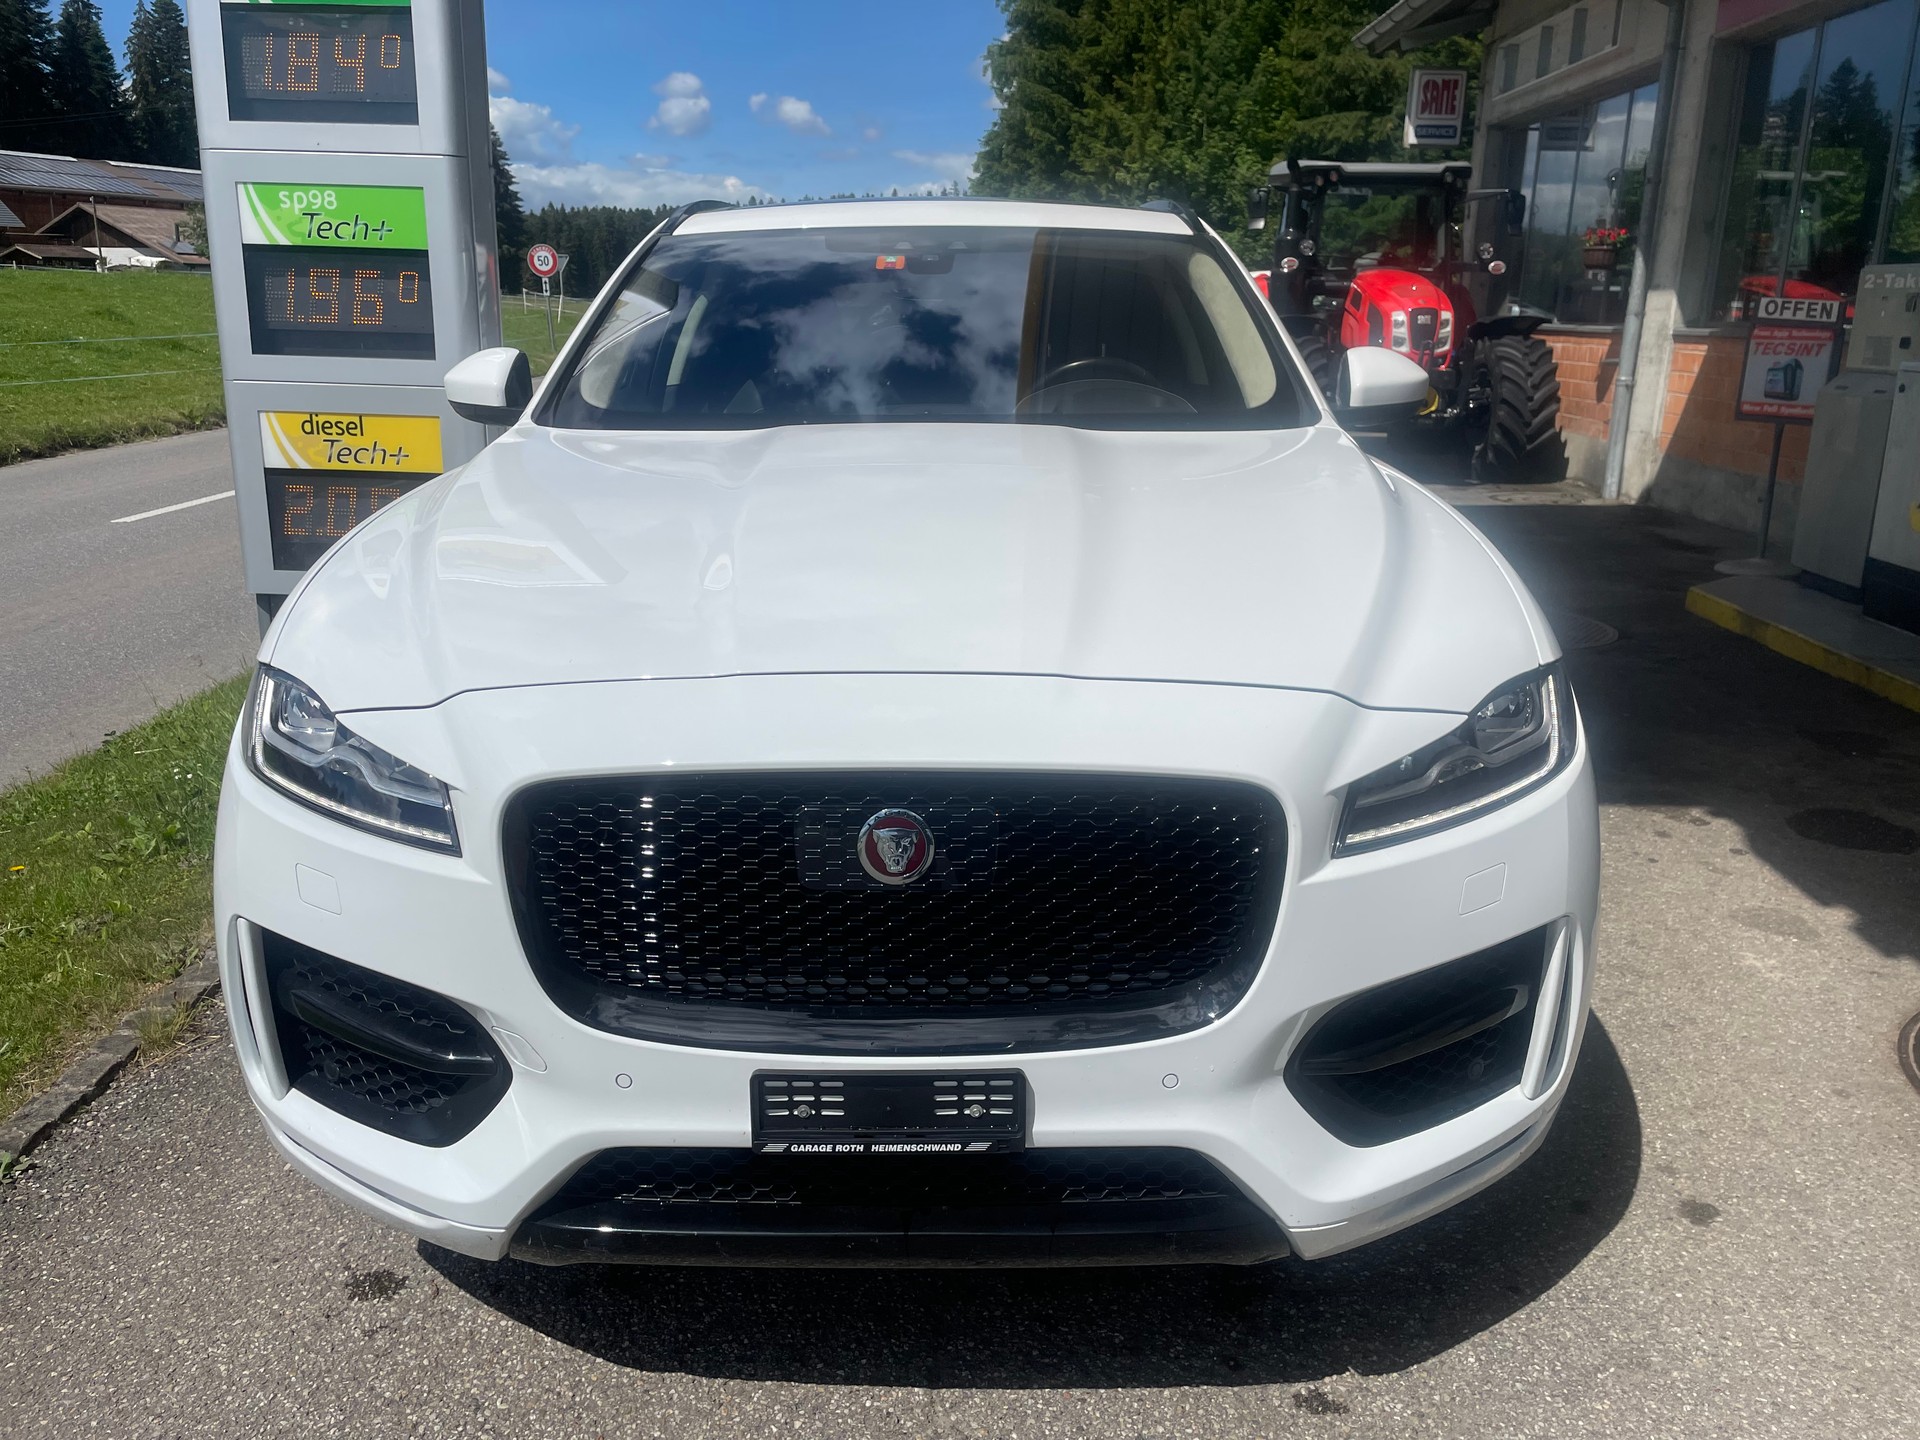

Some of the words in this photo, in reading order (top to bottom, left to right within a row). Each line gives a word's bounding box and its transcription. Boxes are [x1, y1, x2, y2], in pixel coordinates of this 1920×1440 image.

[1420, 79, 1459, 115] SAME
[1416, 126, 1455, 137] SERVICE
[278, 190, 338, 213] sp98
[302, 212, 393, 242] Tech+
[537, 255, 549, 266] 50
[1764, 299, 1834, 320] OFFEN
[1753, 342, 1827, 357] TECSINT
[301, 414, 364, 437] diesel
[322, 439, 410, 466] Tech+
[790, 1143, 833, 1152] GARAGE
[835, 1143, 864, 1152] ROTH
[871, 1143, 962, 1152] HEIMENSCHWAND
